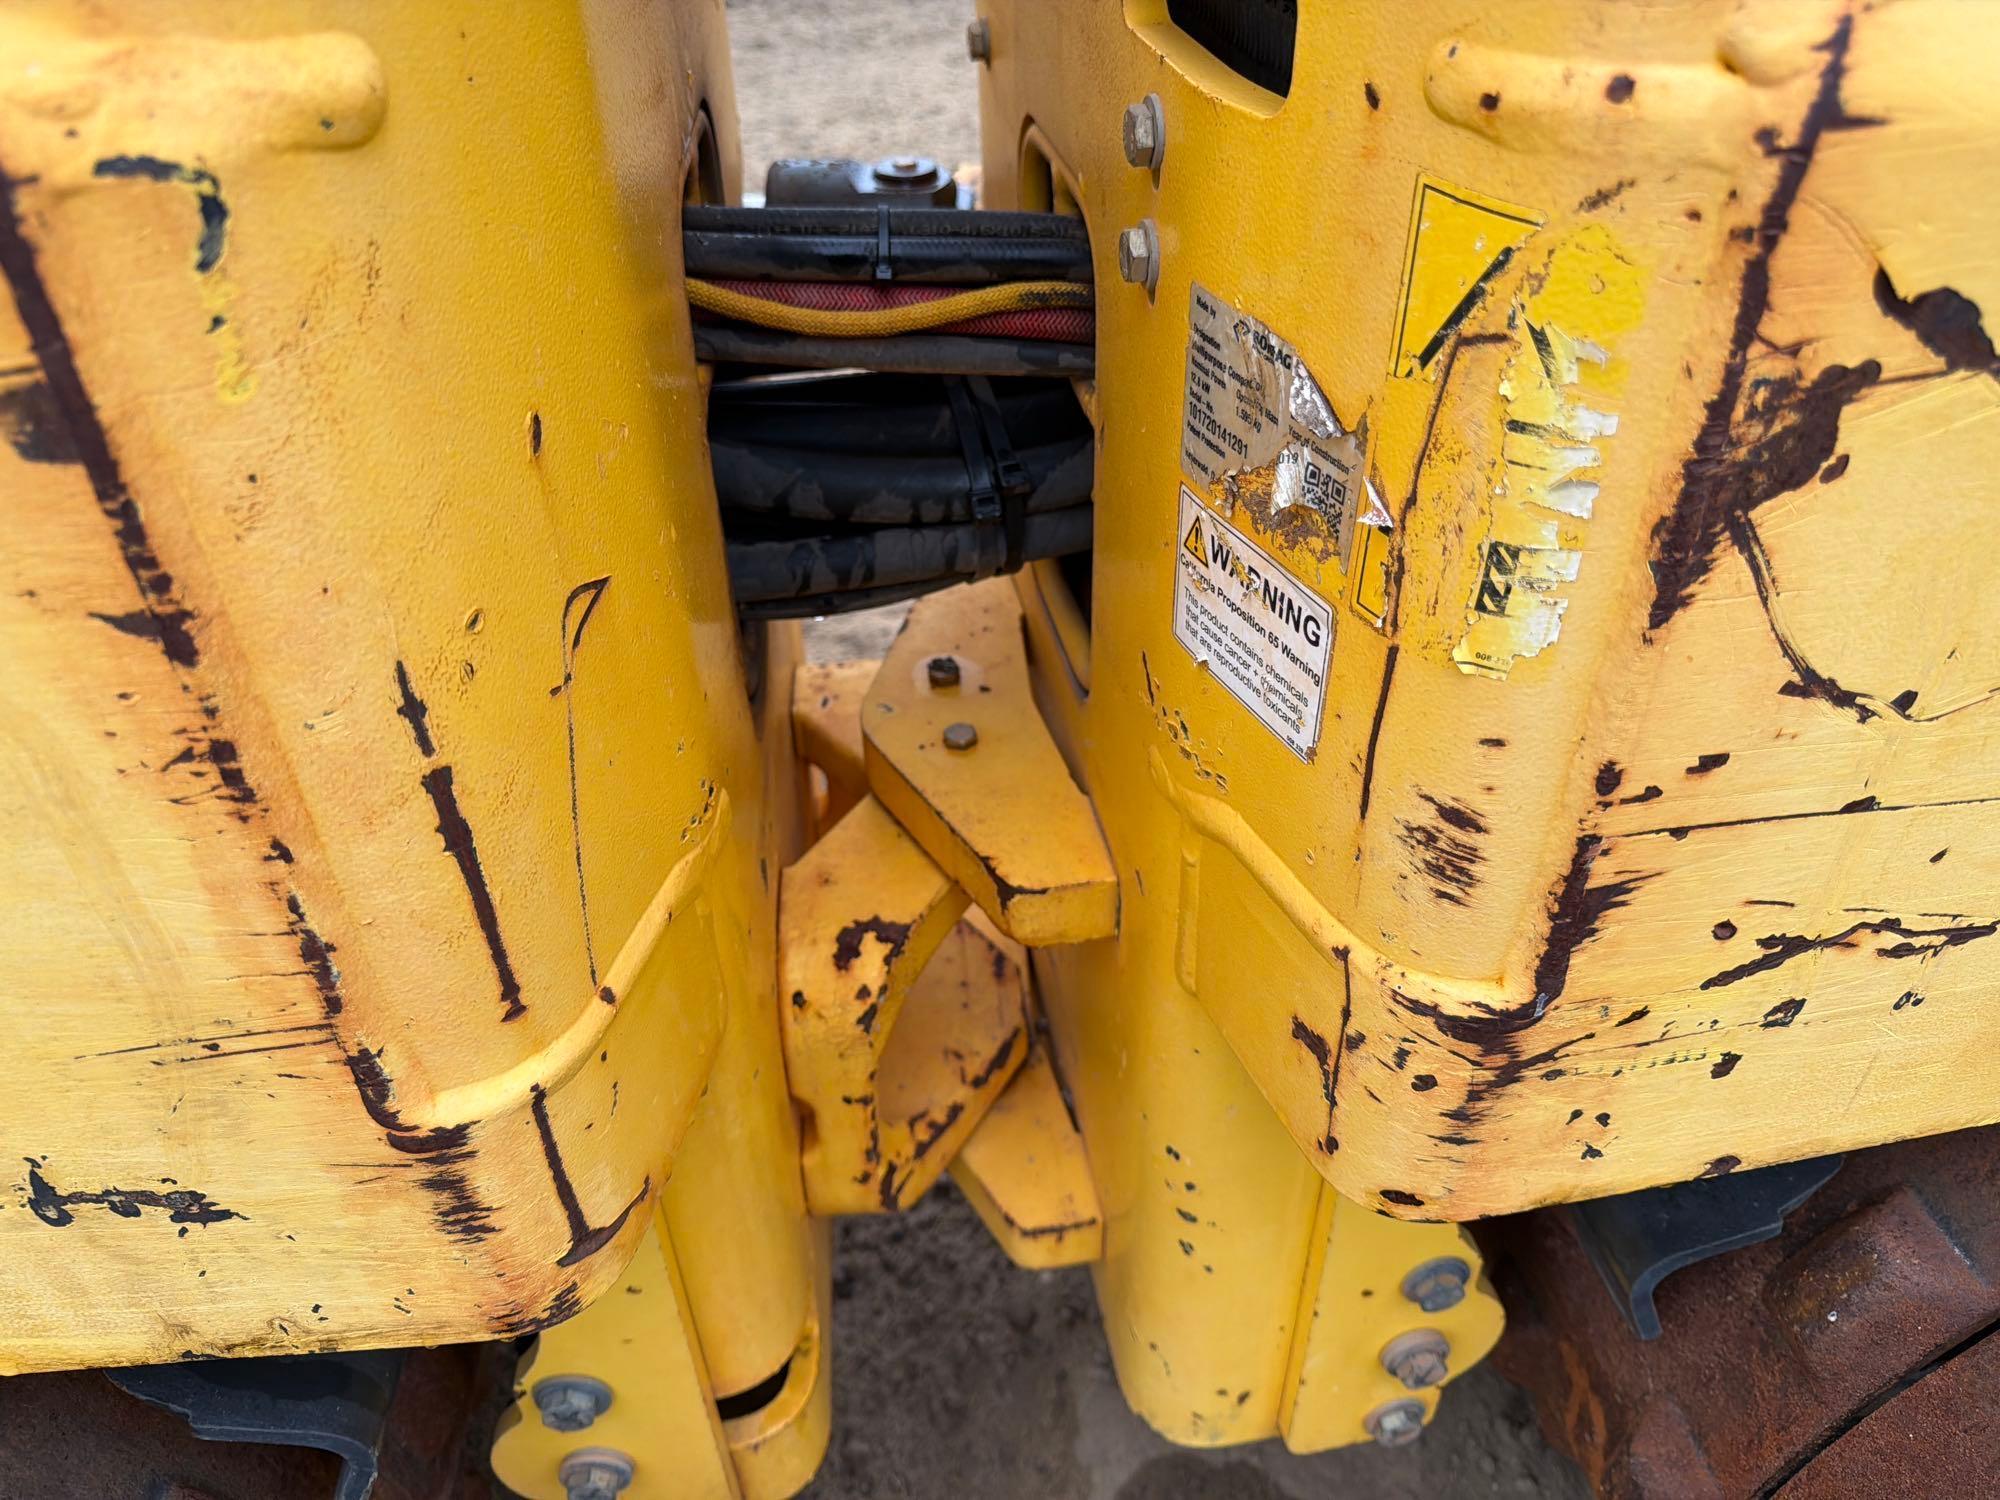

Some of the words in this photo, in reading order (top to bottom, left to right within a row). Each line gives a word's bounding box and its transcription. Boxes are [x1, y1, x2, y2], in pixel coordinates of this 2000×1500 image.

[1189, 401, 1249, 460] 101720141291
[1184, 586, 1199, 610] This
[1200, 602, 1229, 637] product
[1230, 630, 1264, 668] contains
[1265, 661, 1309, 708] chemicals
[1185, 604, 1199, 627] that
[1200, 623, 1223, 648] cause
[1224, 642, 1252, 673] cancer
[1185, 622, 1199, 644] that
[1200, 638, 1213, 656] are
[1213, 648, 1262, 699] reproductive
[1263, 692, 1301, 735] toxicants
[1217, 587, 1267, 638] Proposition
[1268, 631, 1280, 649] 65
[1281, 642, 1321, 687] Warning
